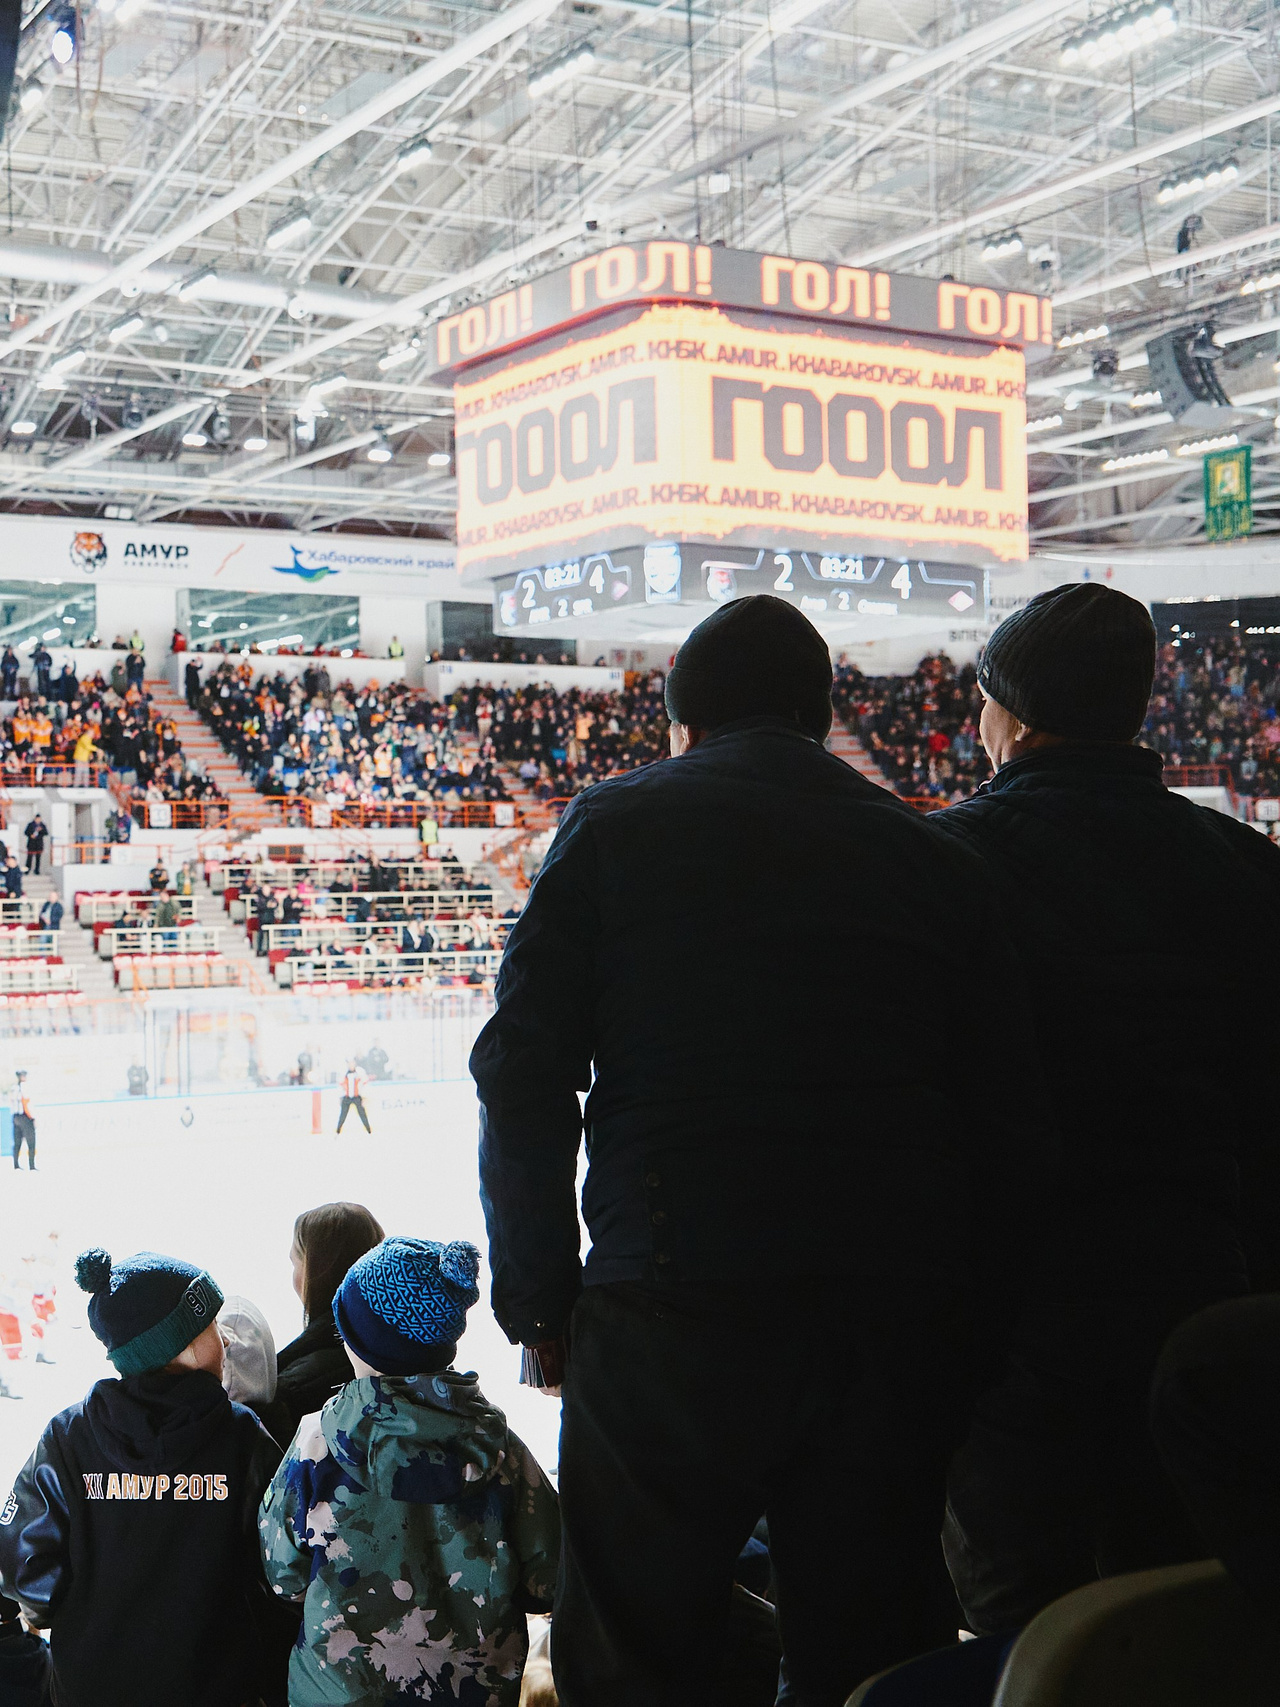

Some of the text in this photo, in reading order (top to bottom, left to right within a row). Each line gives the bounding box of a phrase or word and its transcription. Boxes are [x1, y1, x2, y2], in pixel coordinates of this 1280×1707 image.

[437, 241, 1052, 366] ГОЛ! ГОЛ! ГОЛ! ГОЛ!
[711, 376, 1002, 490] ГОООЛ
[124, 542, 189, 560] АМУР
[308, 550, 455, 569] Хабаровский край
[522, 579, 536, 609] 2
[590, 564, 605, 594] 4
[772, 554, 912, 599] 2 03:21 4
[838, 591, 850, 611] 2
[106, 1473, 171, 1500] АМУР
[173, 1473, 229, 1501] 2015
